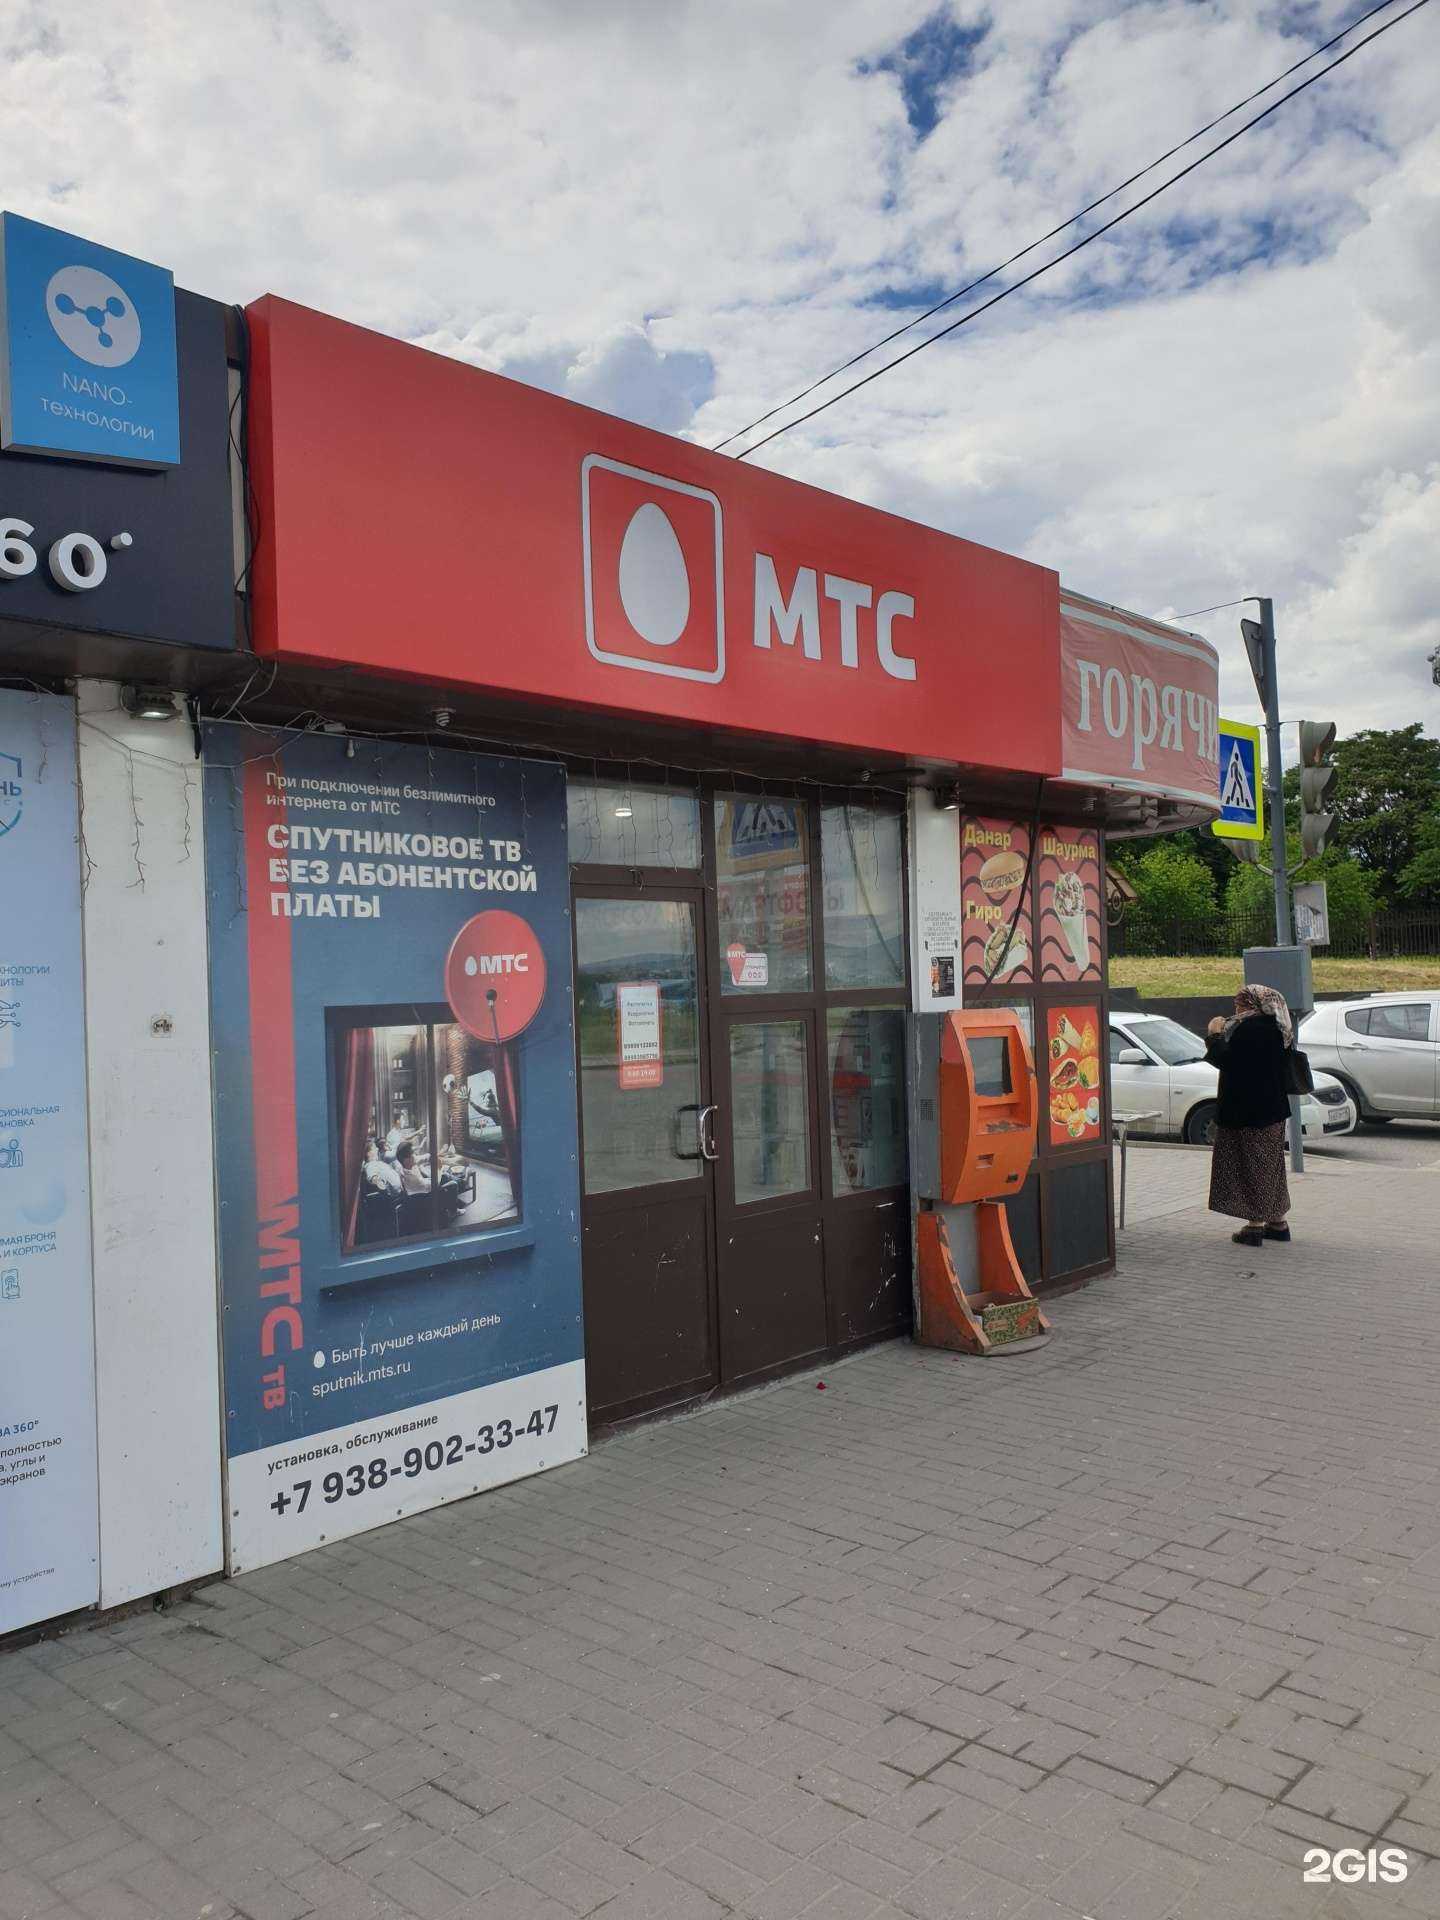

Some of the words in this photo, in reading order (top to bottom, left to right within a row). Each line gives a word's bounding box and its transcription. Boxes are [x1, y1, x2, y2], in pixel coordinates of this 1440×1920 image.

[63, 373, 133, 407] NANO-
[40, 397, 156, 442] технологии
[753, 551, 917, 681] МТС
[266, 772, 297, 789] При
[301, 779, 400, 797] подключении
[403, 785, 496, 807] безлимитного
[266, 795, 347, 812] интернета
[351, 801, 367, 813] от
[371, 804, 401, 815] МТС
[267, 824, 484, 860] СПУТНИКОВОЕ
[490, 839, 522, 862] ТВ
[964, 824, 1012, 851] Данар
[1043, 838, 1097, 861] Шаурма
[269, 858, 330, 885] БЕЗ
[337, 862, 538, 892] АБОНЕНТСКОЙ
[270, 892, 381, 918] ПЛАТЫ
[966, 900, 1003, 923] Гиро
[480, 953, 528, 975] МТС
[12, 1243, 57, 1257] КОРПУСА
[24, 1231, 56, 1243] БРОНЯ
[256, 1180, 304, 1358] МТС
[331, 1346, 367, 1365] Быть
[370, 1333, 415, 1355] лучше
[417, 1318, 469, 1345] каждый
[471, 1312, 502, 1332] день
[311, 1360, 412, 1398] sputnik.mts.ru
[0, 1437, 62, 1459] полностью
[267, 1446, 343, 1476] установка,
[345, 1414, 439, 1450] обслуживание
[270, 1479, 312, 1516] +7
[322, 1403, 560, 1505] 938-902-33-47
[0, 1468, 46, 1486] экранов
[10, 1456, 37, 1472] углы
[39, 1454, 46, 1463] и
